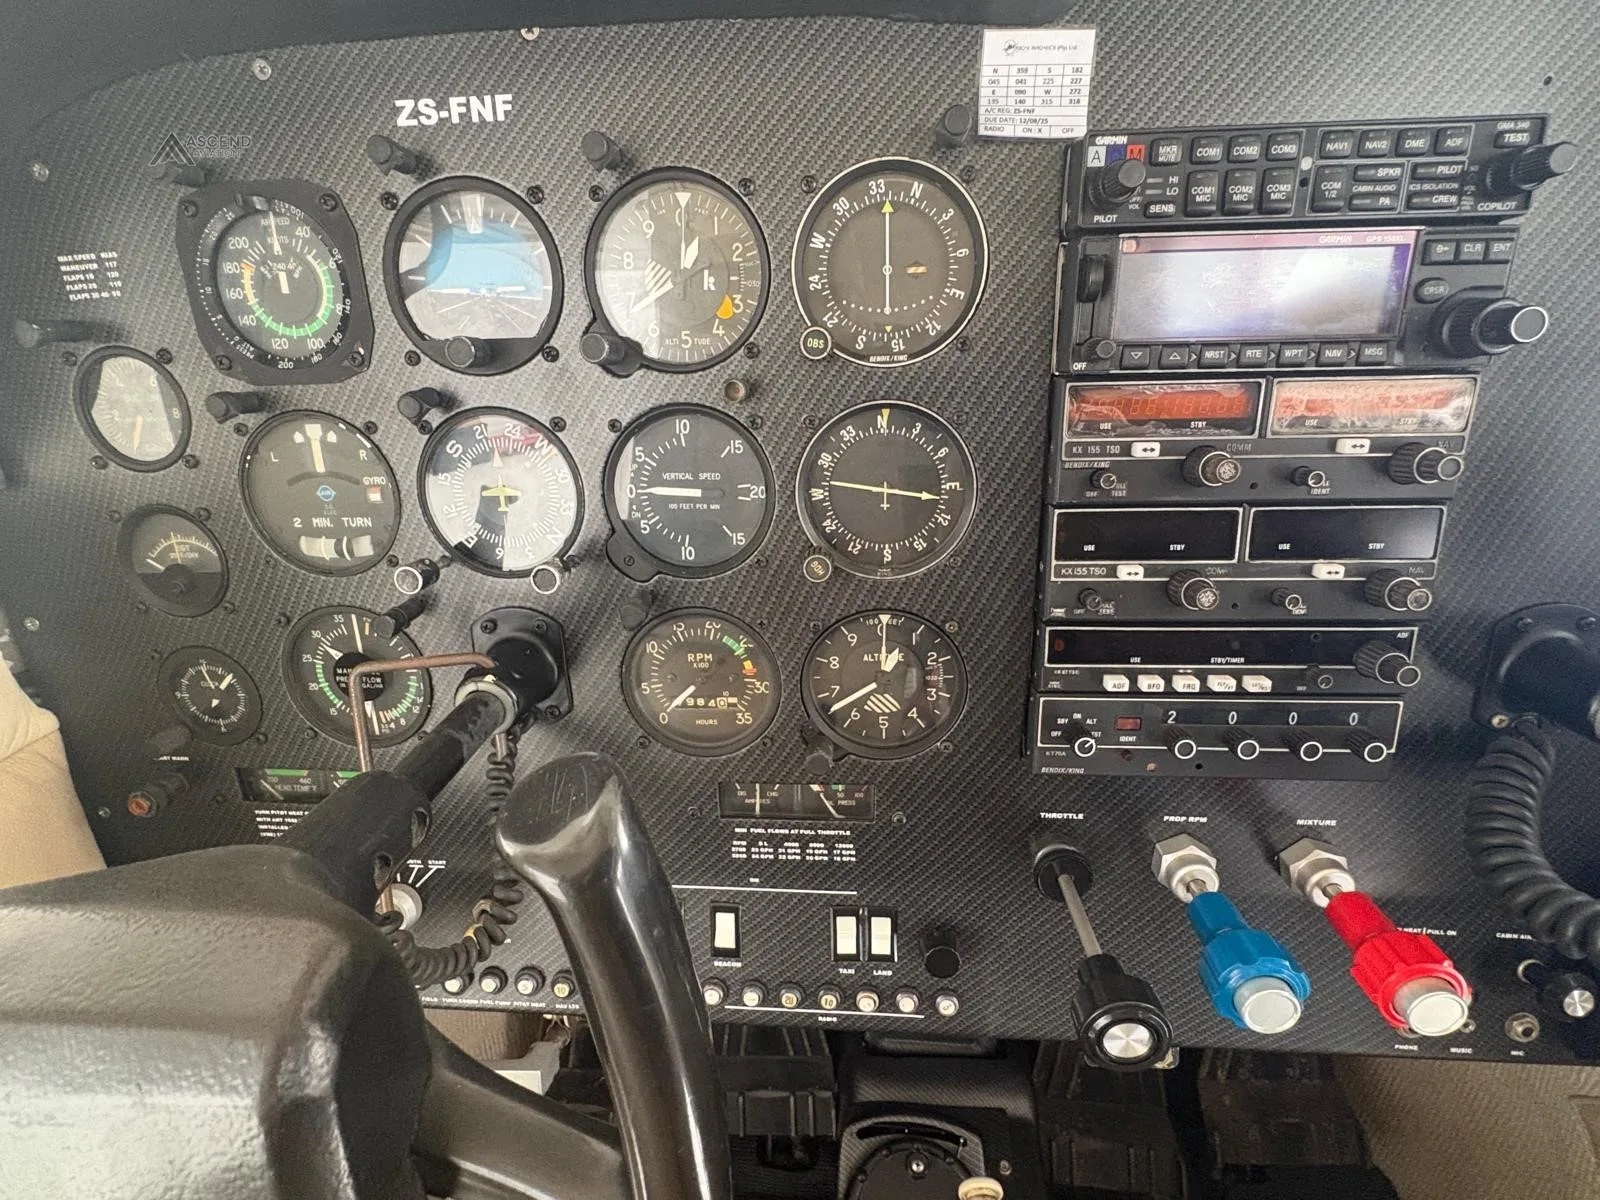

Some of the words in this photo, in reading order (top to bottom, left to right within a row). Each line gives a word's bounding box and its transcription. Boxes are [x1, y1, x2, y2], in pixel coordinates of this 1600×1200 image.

[394, 94, 513, 127] ZS-FNF
[1096, 136, 1127, 144] GARMIN
[1444, 137, 1464, 147] ADF
[1503, 133, 1529, 142] TEST
[1326, 142, 1348, 151] NAV1
[1364, 141, 1388, 150] NAV2
[1405, 139, 1425, 148] DME
[1159, 146, 1177, 154] MKR
[1196, 148, 1221, 157] COM1
[1233, 146, 1258, 155] COM2
[1271, 145, 1296, 154] COM3
[1092, 150, 1100, 163] A
[1158, 154, 1176, 162] MUTE
[1377, 168, 1401, 176] SPKR
[1437, 165, 1463, 174] PILOT
[1169, 176, 1178, 184] HI
[869, 179, 885, 195] 33
[1191, 186, 1215, 194] COM1
[1229, 185, 1253, 194] COM2
[1266, 184, 1291, 193] COM3
[1321, 182, 1341, 190] COM
[1372, 184, 1396, 192] AUDIO
[1421, 182, 1459, 190] ISOLATION
[1166, 187, 1178, 195] LO
[1325, 190, 1337, 198] 1/2
[1195, 194, 1211, 202] MIC
[1232, 193, 1248, 201] MIC
[1270, 192, 1286, 200] MIC
[1432, 195, 1458, 204] CREW
[1379, 197, 1390, 205] PA
[832, 196, 850, 216] 30
[1149, 204, 1173, 213] SENS
[1477, 202, 1517, 211] COPILOT
[1093, 215, 1118, 223] PILOT
[228, 236, 249, 249] 200
[1319, 235, 1352, 244] GARMIN
[732, 243, 743, 261] 2
[1464, 243, 1482, 252] CLR
[1494, 243, 1511, 252] ENT
[222, 262, 240, 274] 180
[225, 287, 243, 300] 160
[238, 315, 257, 326] 140
[712, 319, 725, 336] 4
[272, 338, 289, 349] 120
[307, 338, 324, 349] 100
[681, 331, 692, 348] 5
[807, 338, 824, 348] OBS
[1204, 351, 1224, 359] NRST
[1246, 350, 1262, 358] RTE
[1284, 349, 1304, 357] WPT
[1325, 349, 1342, 358] NAV
[1364, 348, 1383, 356] MSG
[278, 361, 294, 369] 200
[1073, 362, 1086, 370] OFF
[504, 423, 520, 438] 24
[675, 419, 690, 434] 10
[473, 424, 488, 439] 21
[840, 425, 856, 441] 33
[446, 440, 463, 458] S
[730, 440, 744, 453] 15
[1072, 446, 1083, 454] KX
[1106, 445, 1120, 453] TSO
[270, 451, 279, 462] L
[359, 449, 368, 461] R
[818, 452, 833, 469] 30
[362, 476, 386, 485] GYRO
[750, 486, 766, 499] 20
[293, 517, 303, 528] 2
[312, 517, 333, 527] MIN.
[341, 517, 372, 527] TURN
[732, 533, 746, 545] 15
[681, 547, 695, 560] 10
[1090, 567, 1107, 575] TSO
[688, 653, 713, 662] RPM
[829, 656, 840, 669] 8
[926, 688, 936, 701] 3
[736, 713, 753, 725] 35
[1167, 711, 1177, 724] 2
